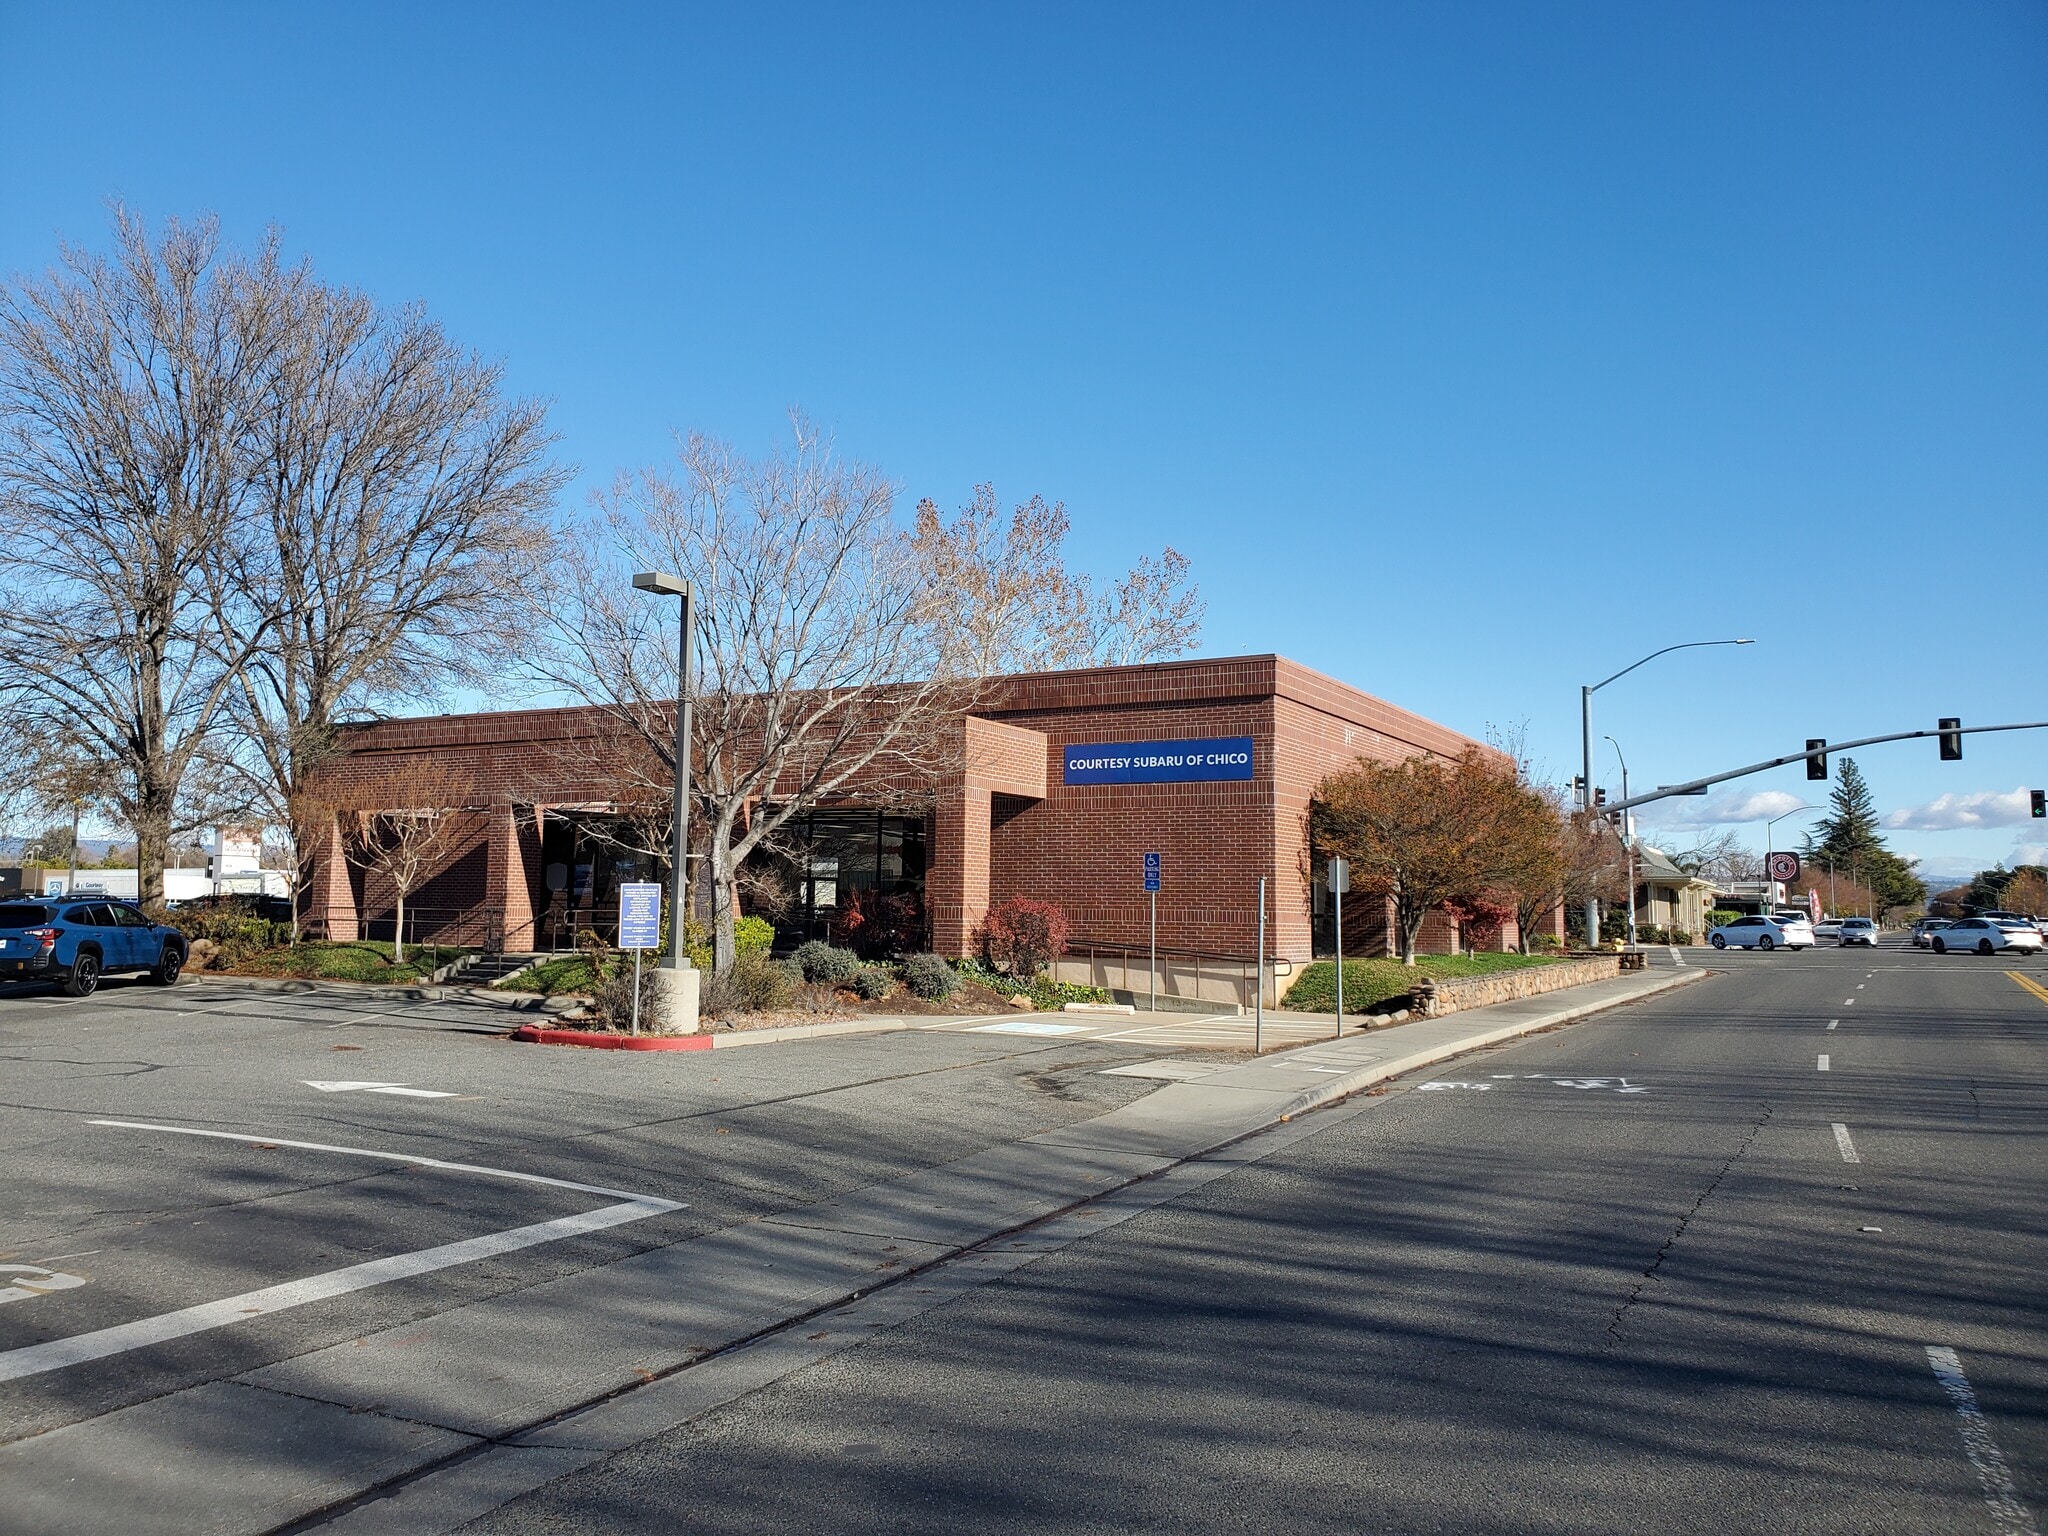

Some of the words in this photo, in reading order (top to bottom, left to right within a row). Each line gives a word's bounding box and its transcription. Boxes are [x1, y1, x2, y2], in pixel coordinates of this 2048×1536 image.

[1069, 757, 1132, 770] COURTESY
[1133, 755, 1183, 768] SUBARU
[1186, 754, 1204, 766] OF
[1206, 752, 1248, 765] CHICO
